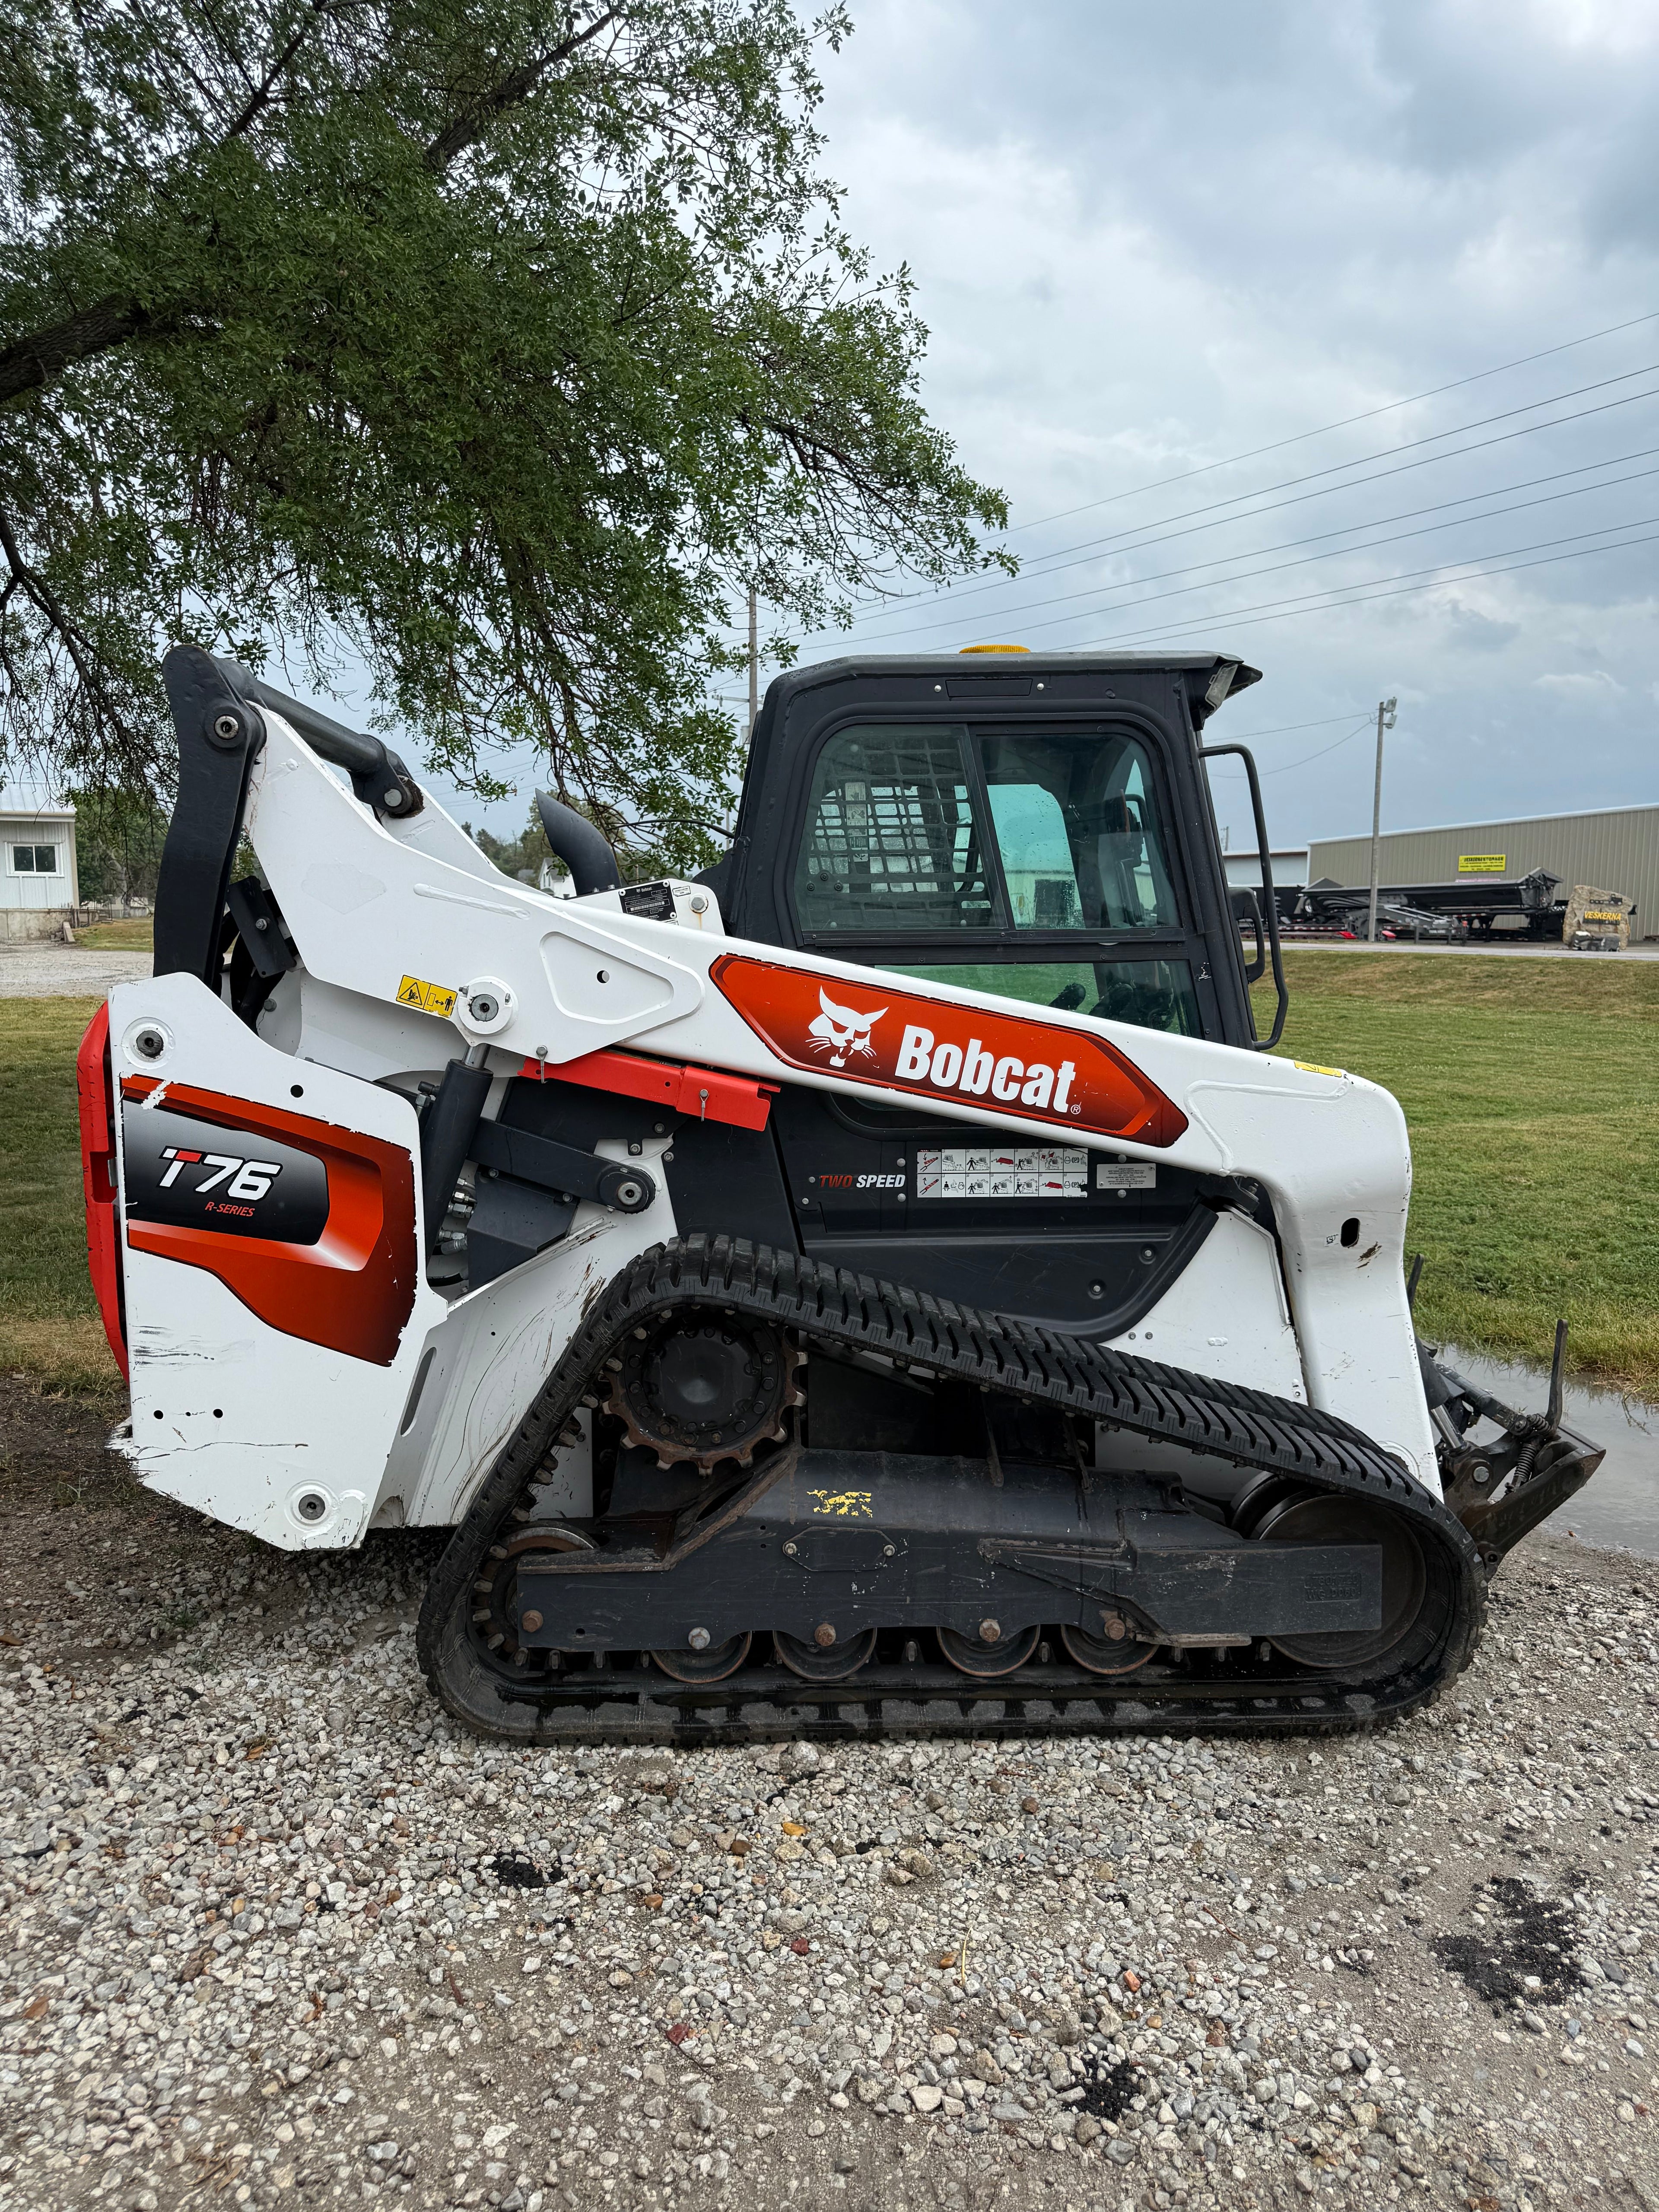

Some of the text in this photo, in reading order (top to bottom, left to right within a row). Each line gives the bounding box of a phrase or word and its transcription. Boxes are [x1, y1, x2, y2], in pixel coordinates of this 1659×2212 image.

[1584, 911, 1621, 920] VESKERNA
[894, 1024, 1076, 1113] Bobcat
[159, 1147, 282, 1201] T76
[820, 1174, 906, 1188] TWO SPEED
[204, 1201, 255, 1217] R-SERIES
